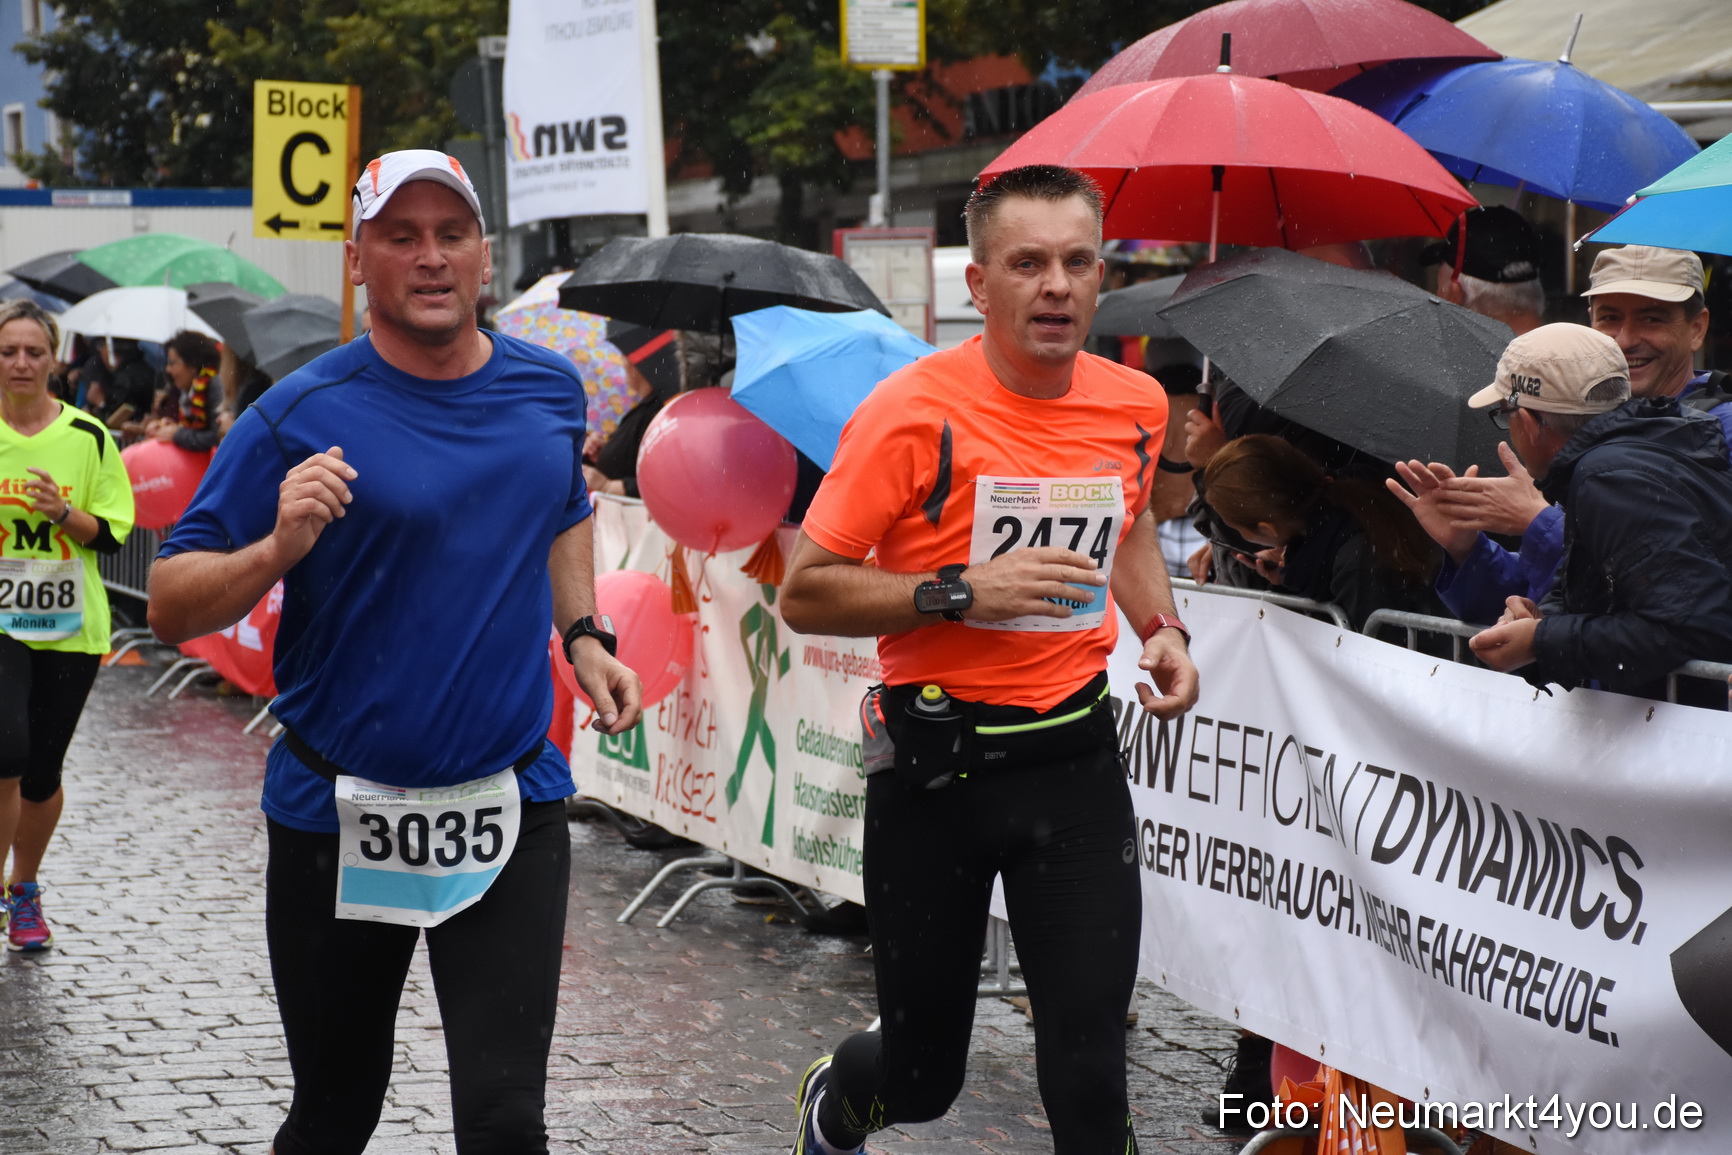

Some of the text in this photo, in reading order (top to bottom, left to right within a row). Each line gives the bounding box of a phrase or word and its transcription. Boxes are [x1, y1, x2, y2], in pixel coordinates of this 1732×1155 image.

[268, 89, 347, 119] Block
[280, 131, 331, 207] C
[990, 494, 1041, 504] NeuerMarkt
[1050, 483, 1115, 501] BOCK
[12, 519, 53, 552] M
[0, 579, 75, 610] 2068
[11, 617, 57, 630] Monika
[1110, 696, 1185, 794] MW
[359, 805, 504, 868] 3035
[1195, 832, 1362, 936] VERBRAUCH.
[1359, 886, 1418, 971] MEHR
[1416, 916, 1620, 1049] FAHRFREUDE.
